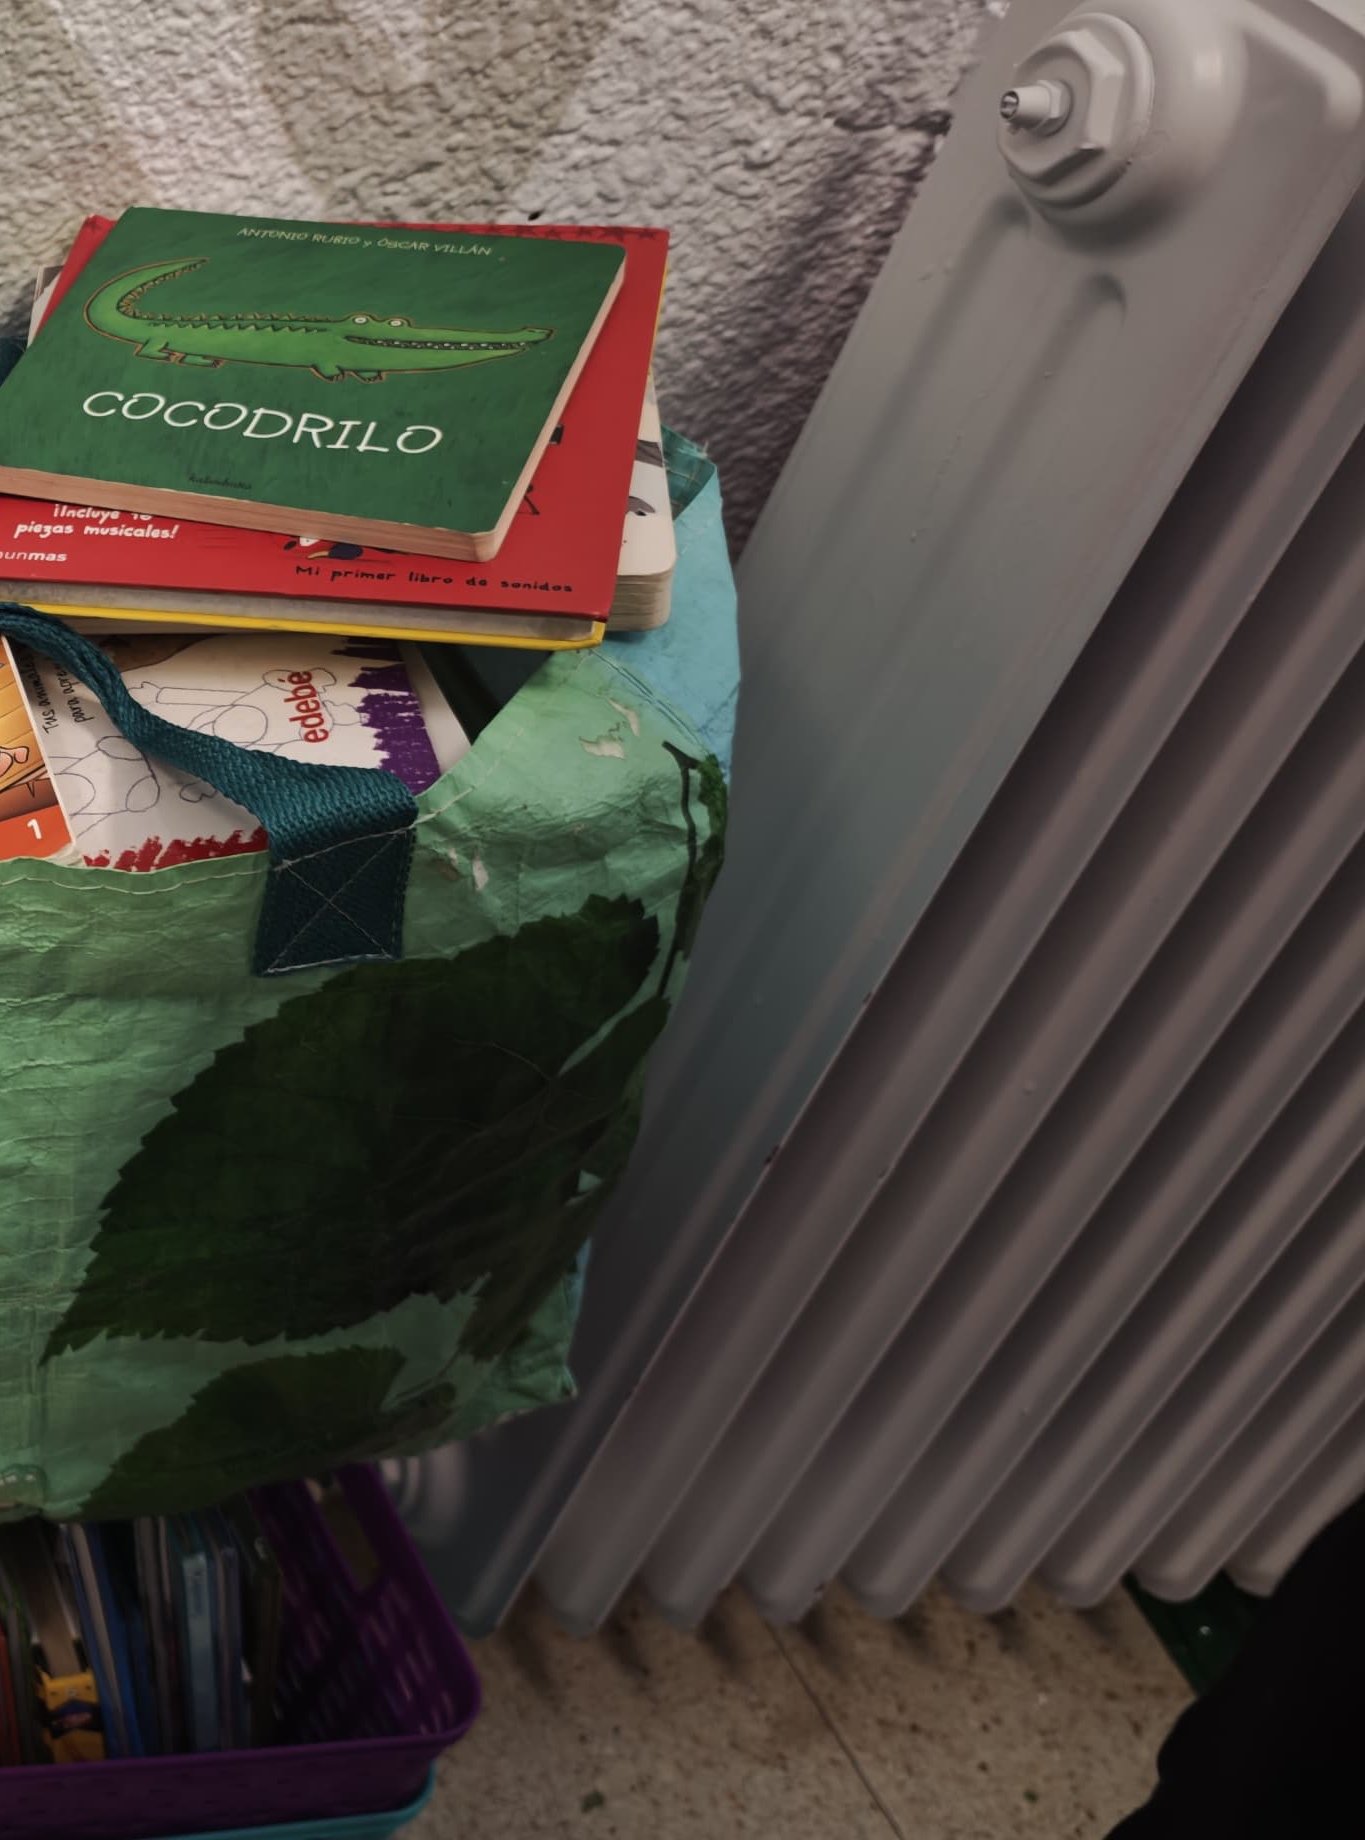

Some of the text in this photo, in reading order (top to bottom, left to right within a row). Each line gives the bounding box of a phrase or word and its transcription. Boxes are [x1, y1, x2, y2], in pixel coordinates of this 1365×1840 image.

[236, 227, 308, 242] ANTONIO
[312, 232, 360, 246] RUBIO
[82, 391, 443, 454] COCODRILO
[83, 523, 180, 539] musicales!
[330, 568, 396, 581] primer
[408, 570, 454, 584] libro
[465, 576, 488, 588] de
[500, 578, 574, 593] sonidos
[276, 670, 330, 743] edebé
[26, 817, 43, 840] 1
